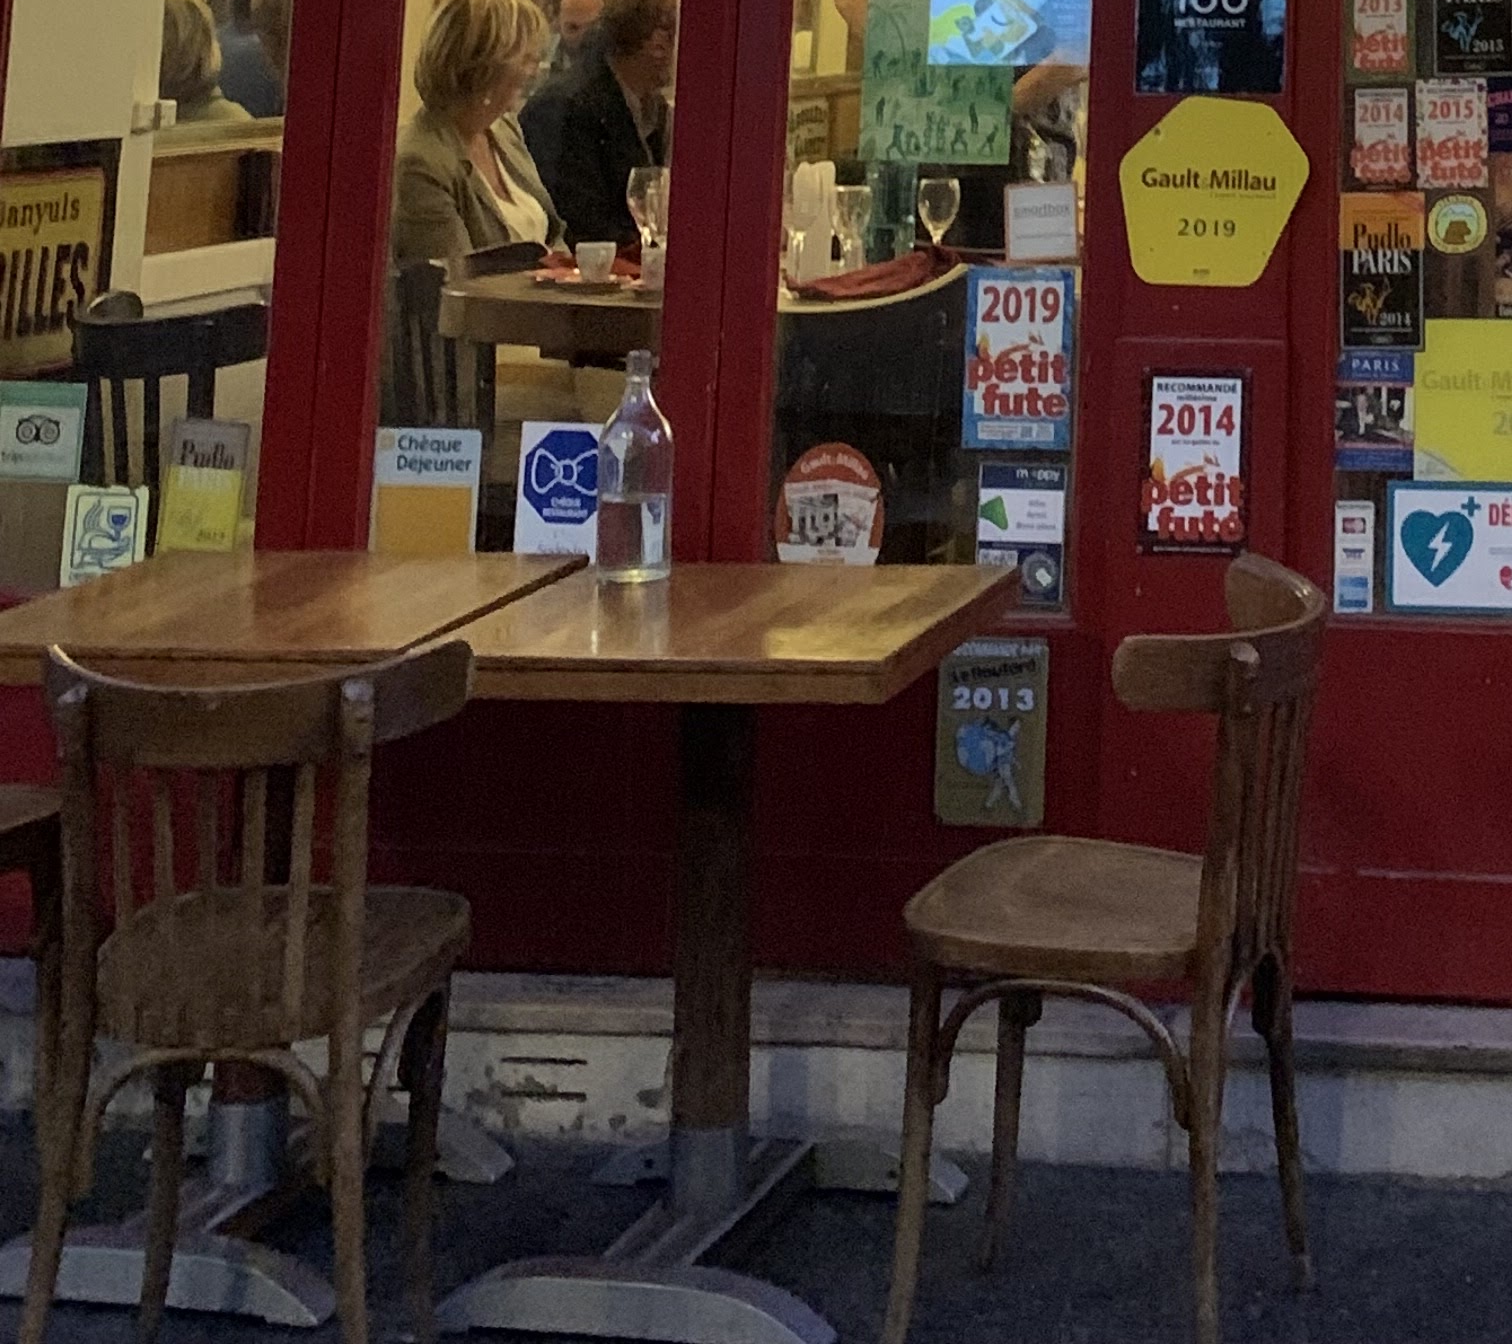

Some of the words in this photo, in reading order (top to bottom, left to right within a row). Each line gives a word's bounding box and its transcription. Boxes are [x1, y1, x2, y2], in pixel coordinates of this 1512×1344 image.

[1359, 103, 1404, 123] 2014
[1427, 98, 1474, 120] 2015
[1176, 218, 1237, 238] 2019
[1353, 222, 1412, 250] Pudlo
[1352, 248, 1412, 275] PARIS
[980, 285, 1061, 325] 2019
[966, 350, 1069, 390] petit
[1350, 358, 1400, 372] PARIS
[1156, 382, 1238, 394] RECOMMANDÉ
[1156, 403, 1236, 437] 2014
[396, 432, 463, 455] Chèque
[395, 452, 473, 474] Déjeuner
[1141, 469, 1246, 512] petit
[952, 685, 1035, 711] 2013
